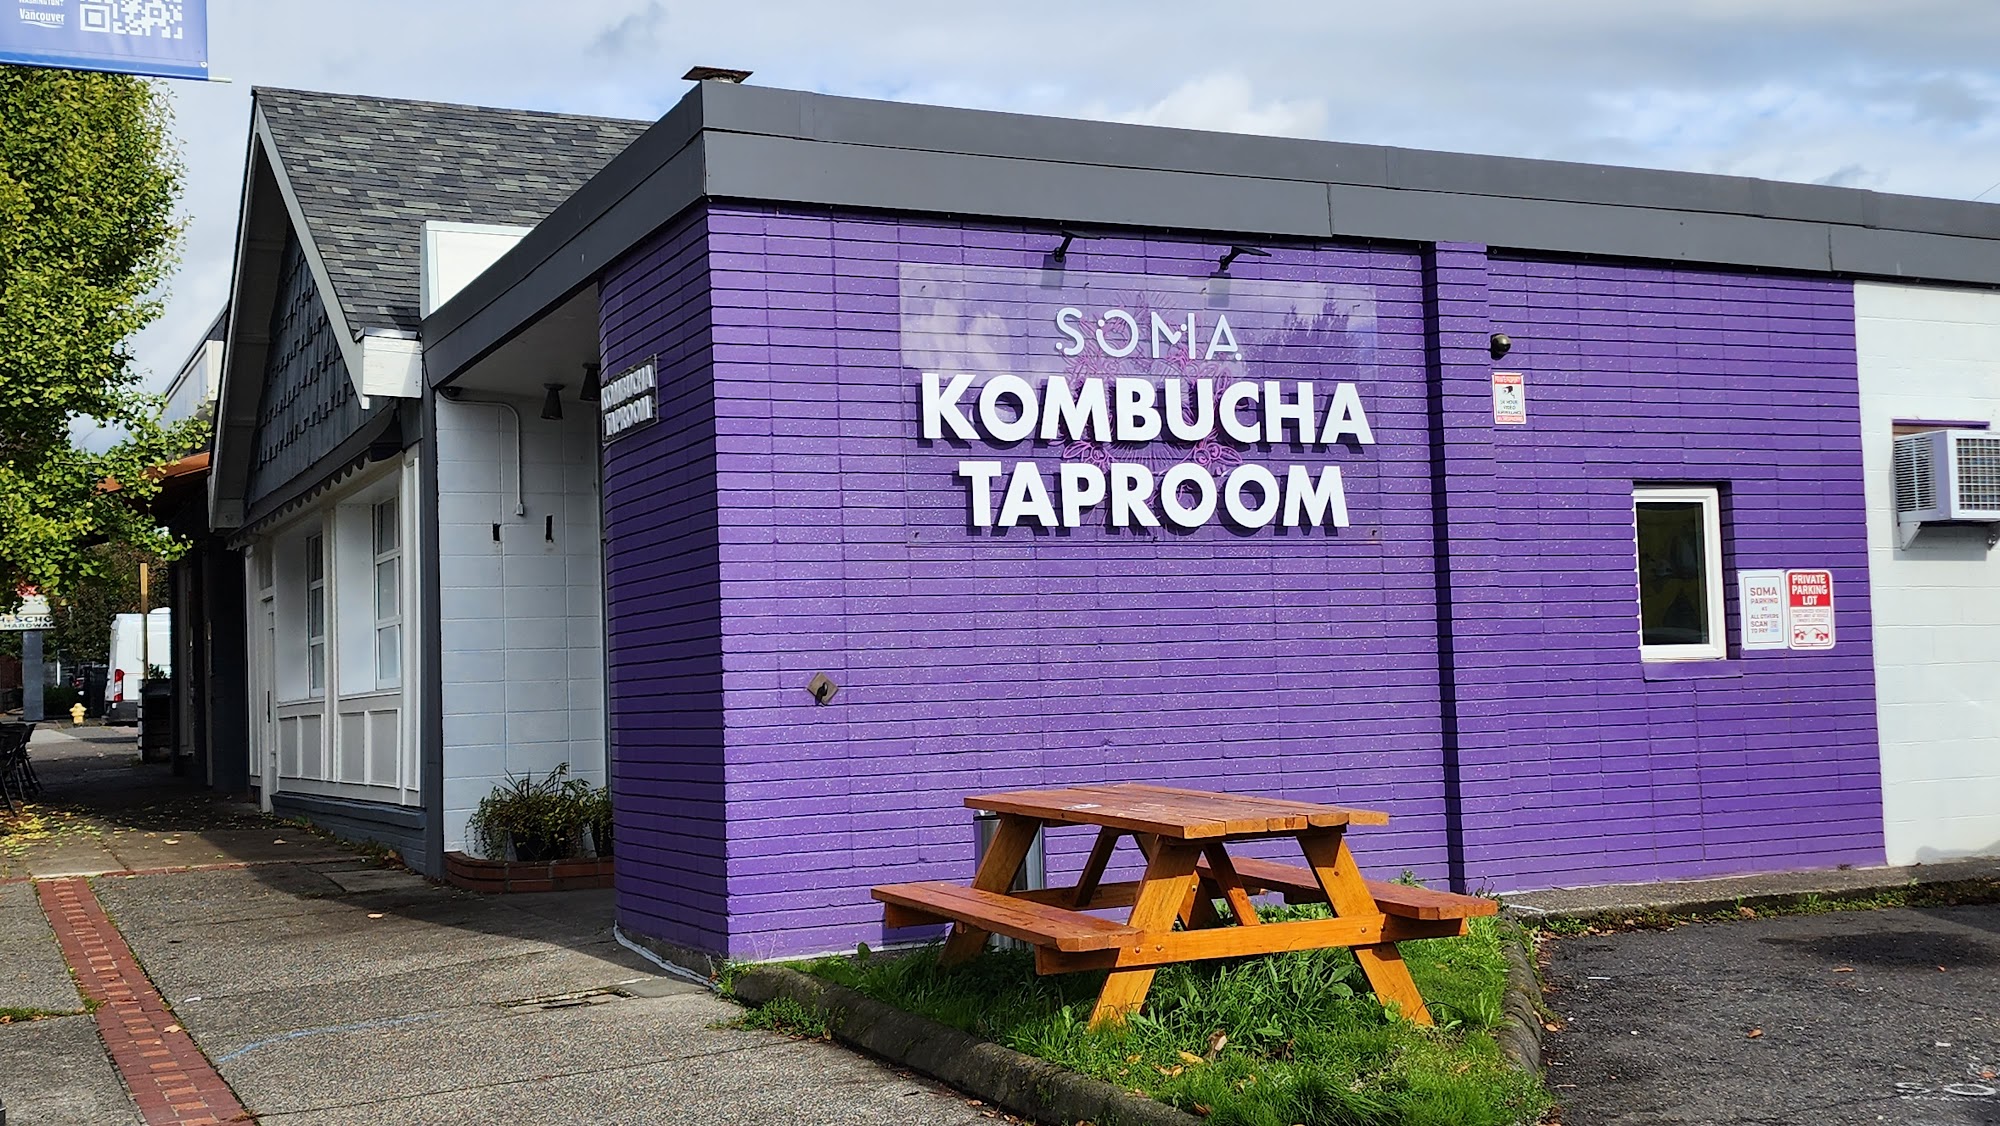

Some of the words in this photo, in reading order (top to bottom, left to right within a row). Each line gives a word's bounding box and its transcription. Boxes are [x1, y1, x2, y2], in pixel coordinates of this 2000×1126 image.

[19, 8, 65, 22] Vancouver
[1055, 307, 1243, 361] SOMA
[601, 364, 655, 410] KOMBUCHA
[605, 395, 653, 436] TAPROOM
[921, 373, 1375, 445] KOMBUCHA
[958, 460, 1350, 528] TAPROOM
[1792, 574, 1826, 585] PRIVATE
[1750, 587, 1777, 597] SOMA
[1792, 585, 1828, 595] PARKING
[1802, 595, 1818, 606] LOT
[1750, 620, 1768, 628] SCAN
